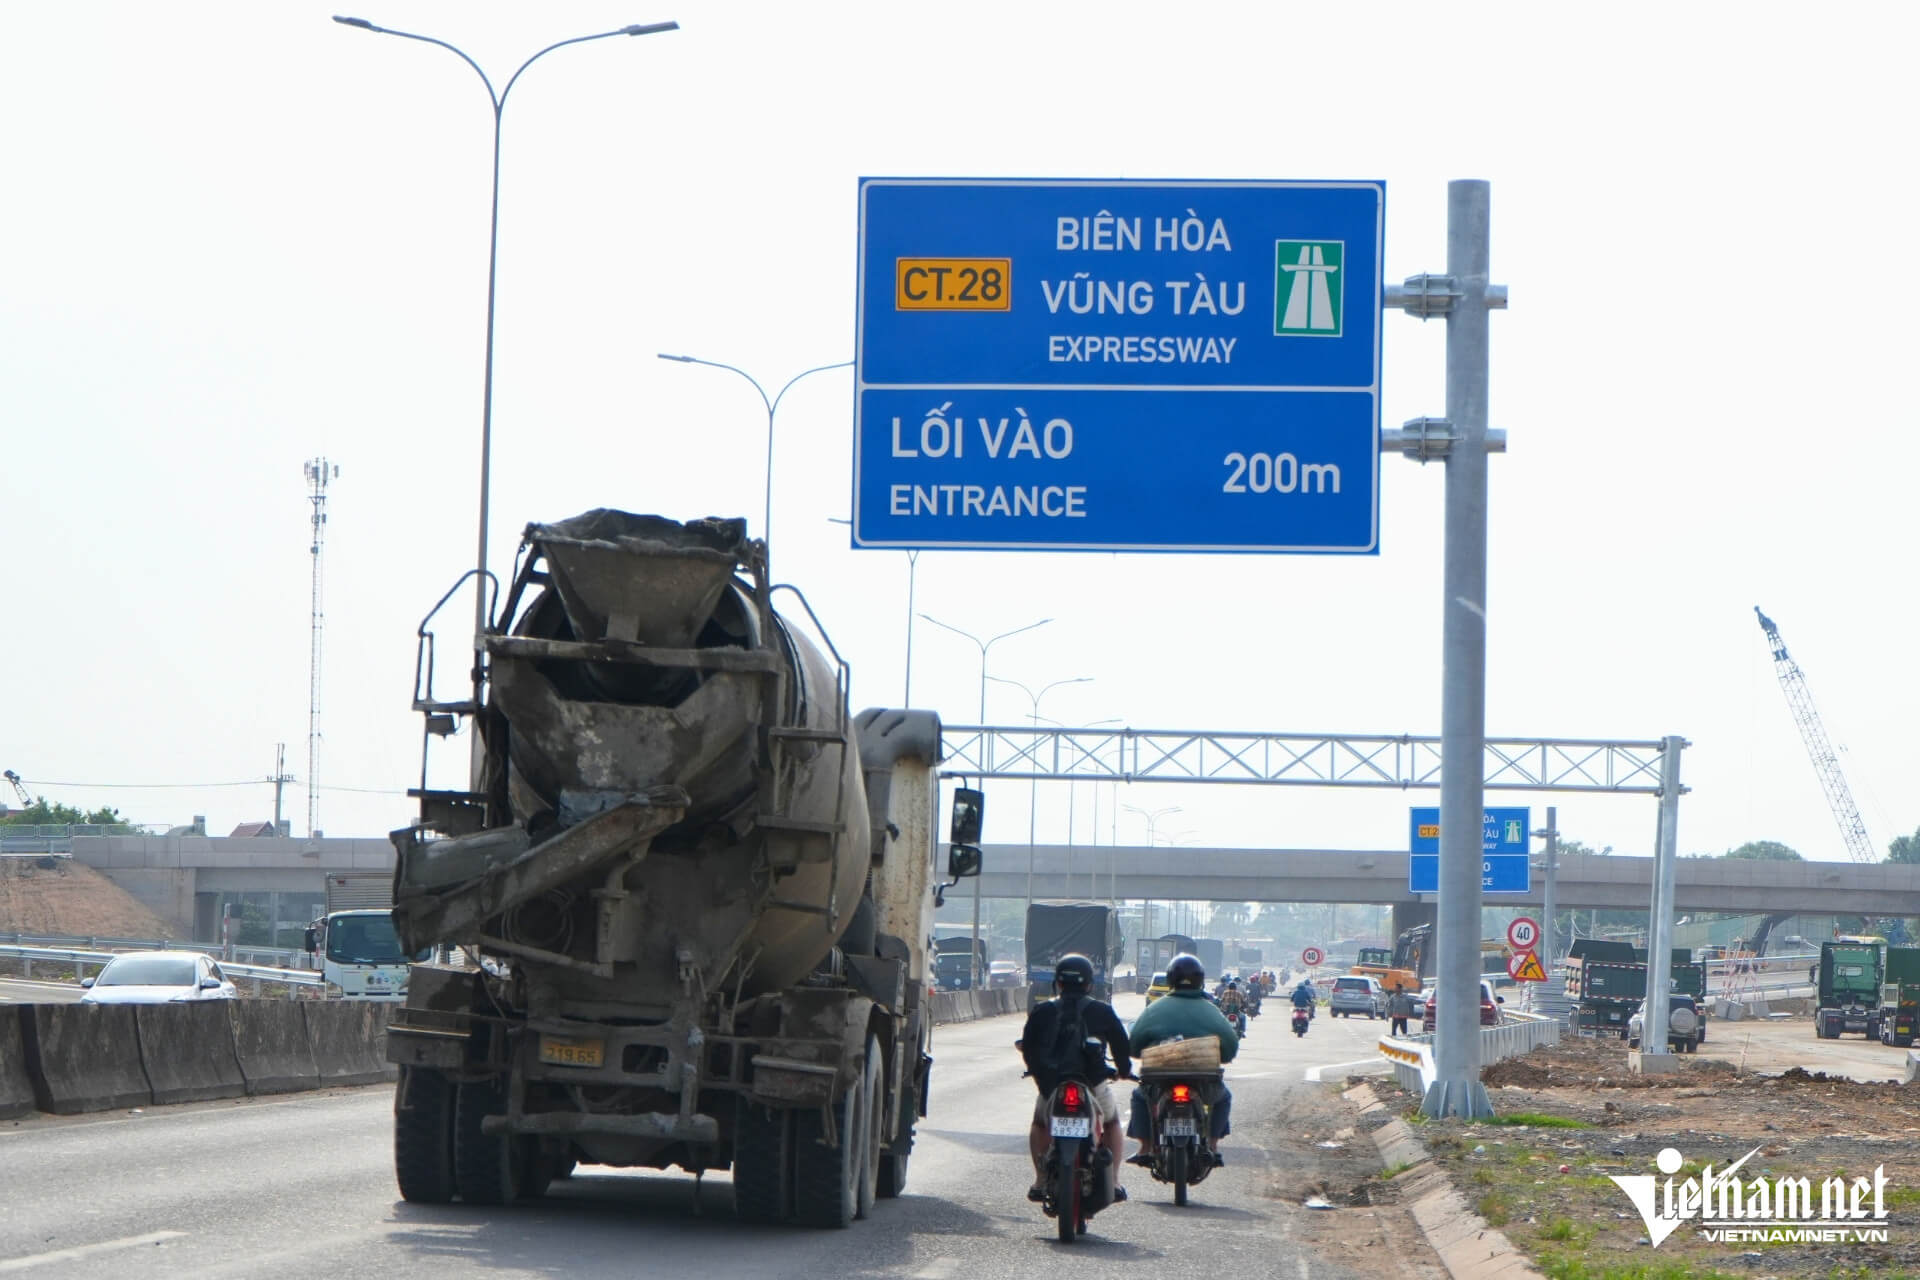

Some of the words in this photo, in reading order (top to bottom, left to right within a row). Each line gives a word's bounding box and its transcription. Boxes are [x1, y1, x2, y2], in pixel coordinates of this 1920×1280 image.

[1056, 209, 1142, 251] BIÊN
[1155, 208, 1232, 252] HÒA
[903, 267, 1002, 302] CT.28
[1041, 272, 1154, 315] VŨNG
[1166, 272, 1246, 316] TÀU
[1049, 336, 1237, 364] EXPRESSWAY
[892, 401, 963, 458] LỐI
[978, 407, 1074, 460] VÀO
[1223, 452, 1341, 494] 200m
[890, 484, 1087, 518] ENTRANCE
[1419, 827, 1440, 836] CT.2
[1516, 927, 1530, 940] 40
